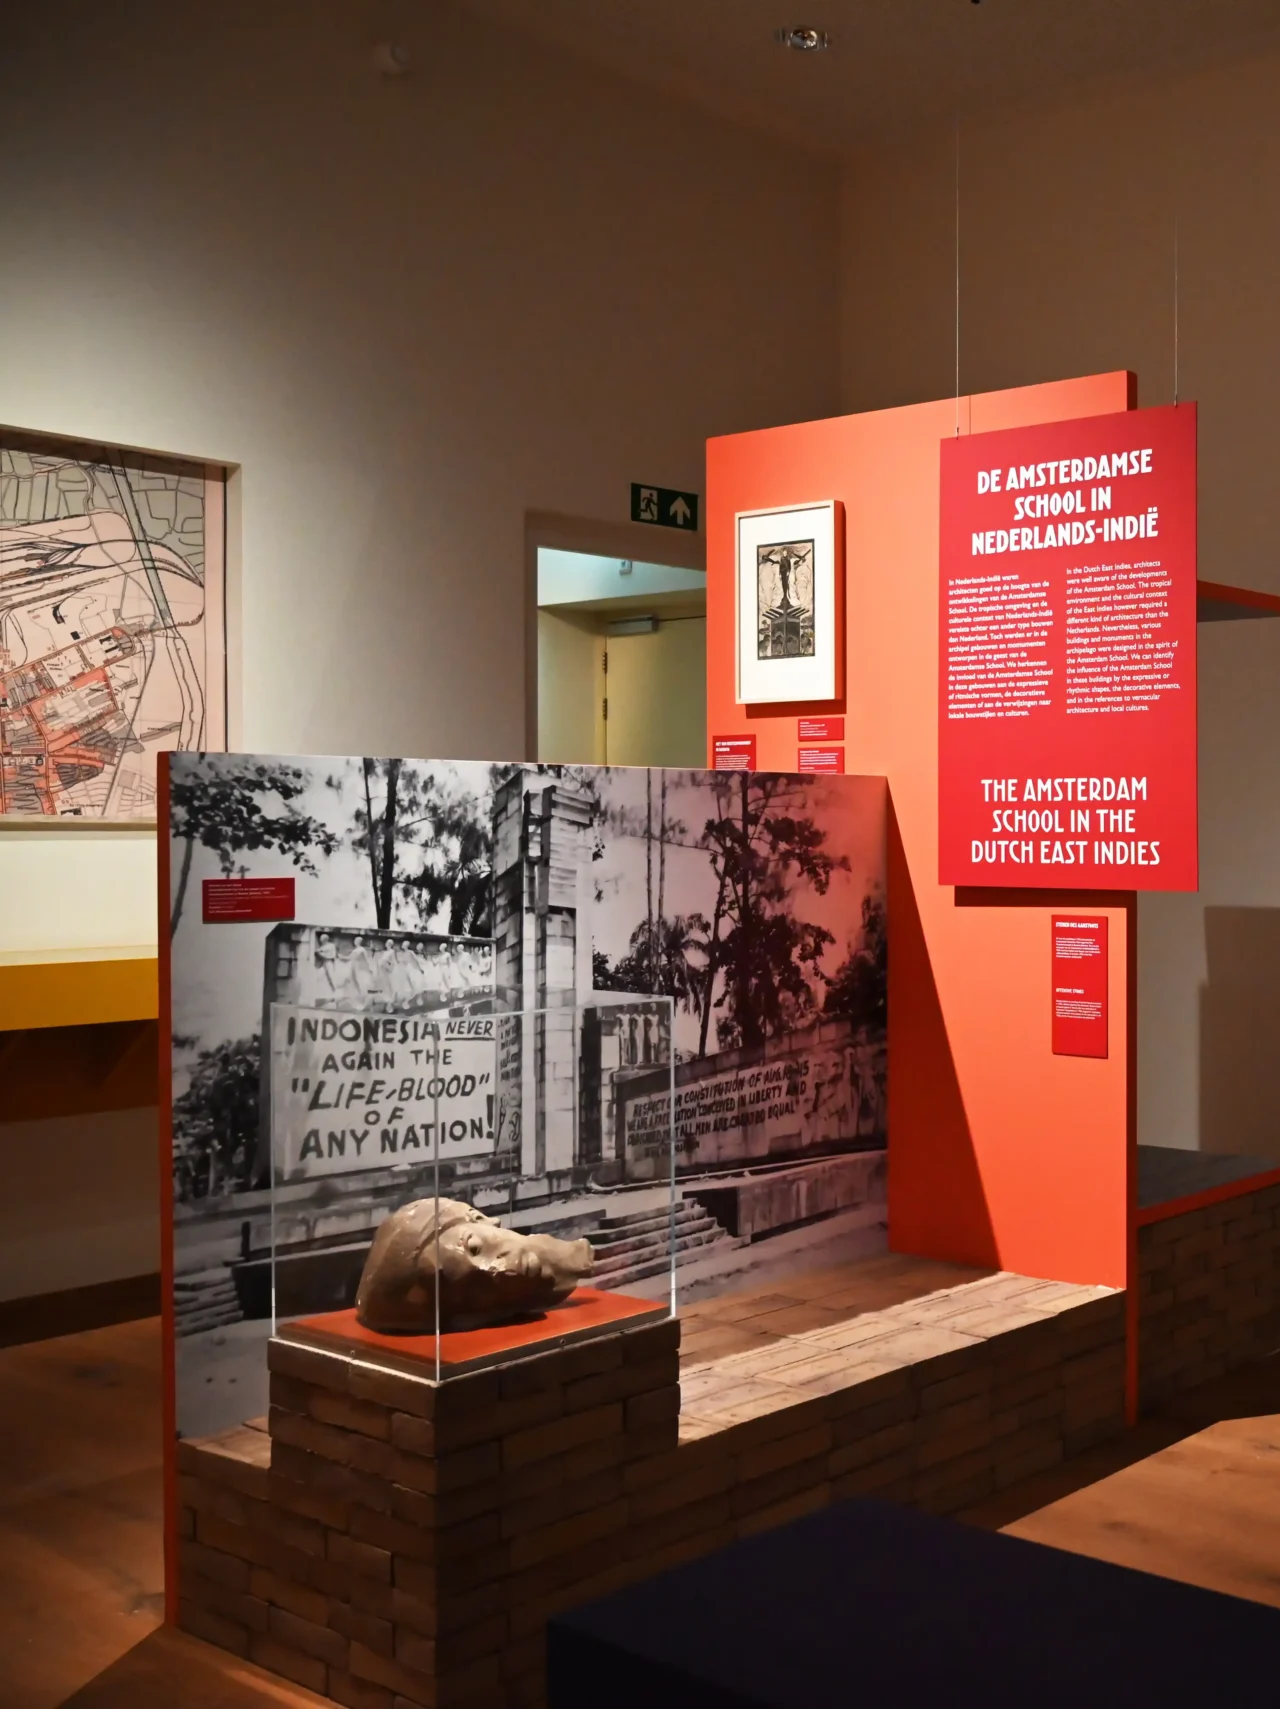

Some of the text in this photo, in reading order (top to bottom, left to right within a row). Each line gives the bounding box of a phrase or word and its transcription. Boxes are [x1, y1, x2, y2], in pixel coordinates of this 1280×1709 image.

[978, 448, 1152, 494] DE AMSTERDAMSE
[1014, 486, 1111, 520] SCHOOL IN
[972, 507, 1158, 555] NEDERLANDS-INDIË
[1129, 571, 1167, 579] developments
[1150, 579, 1172, 588] tropical
[979, 586, 993, 594] goed
[1139, 601, 1162, 609] required
[1113, 644, 1136, 652] designed
[1153, 651, 1174, 659] identify
[981, 777, 1147, 802] THE AMSTERDAM
[992, 810, 1135, 832] SCHOOL IN THE
[972, 841, 1160, 865] DUTCH EAST INDIES
[287, 1018, 492, 1045] INDONESIA NEVER
[322, 1049, 452, 1073] AGAIN THE
[292, 1073, 490, 1110] "LIFE-BLOOD"
[365, 1107, 404, 1125] OF
[299, 1095, 494, 1162] ANY NATION!
